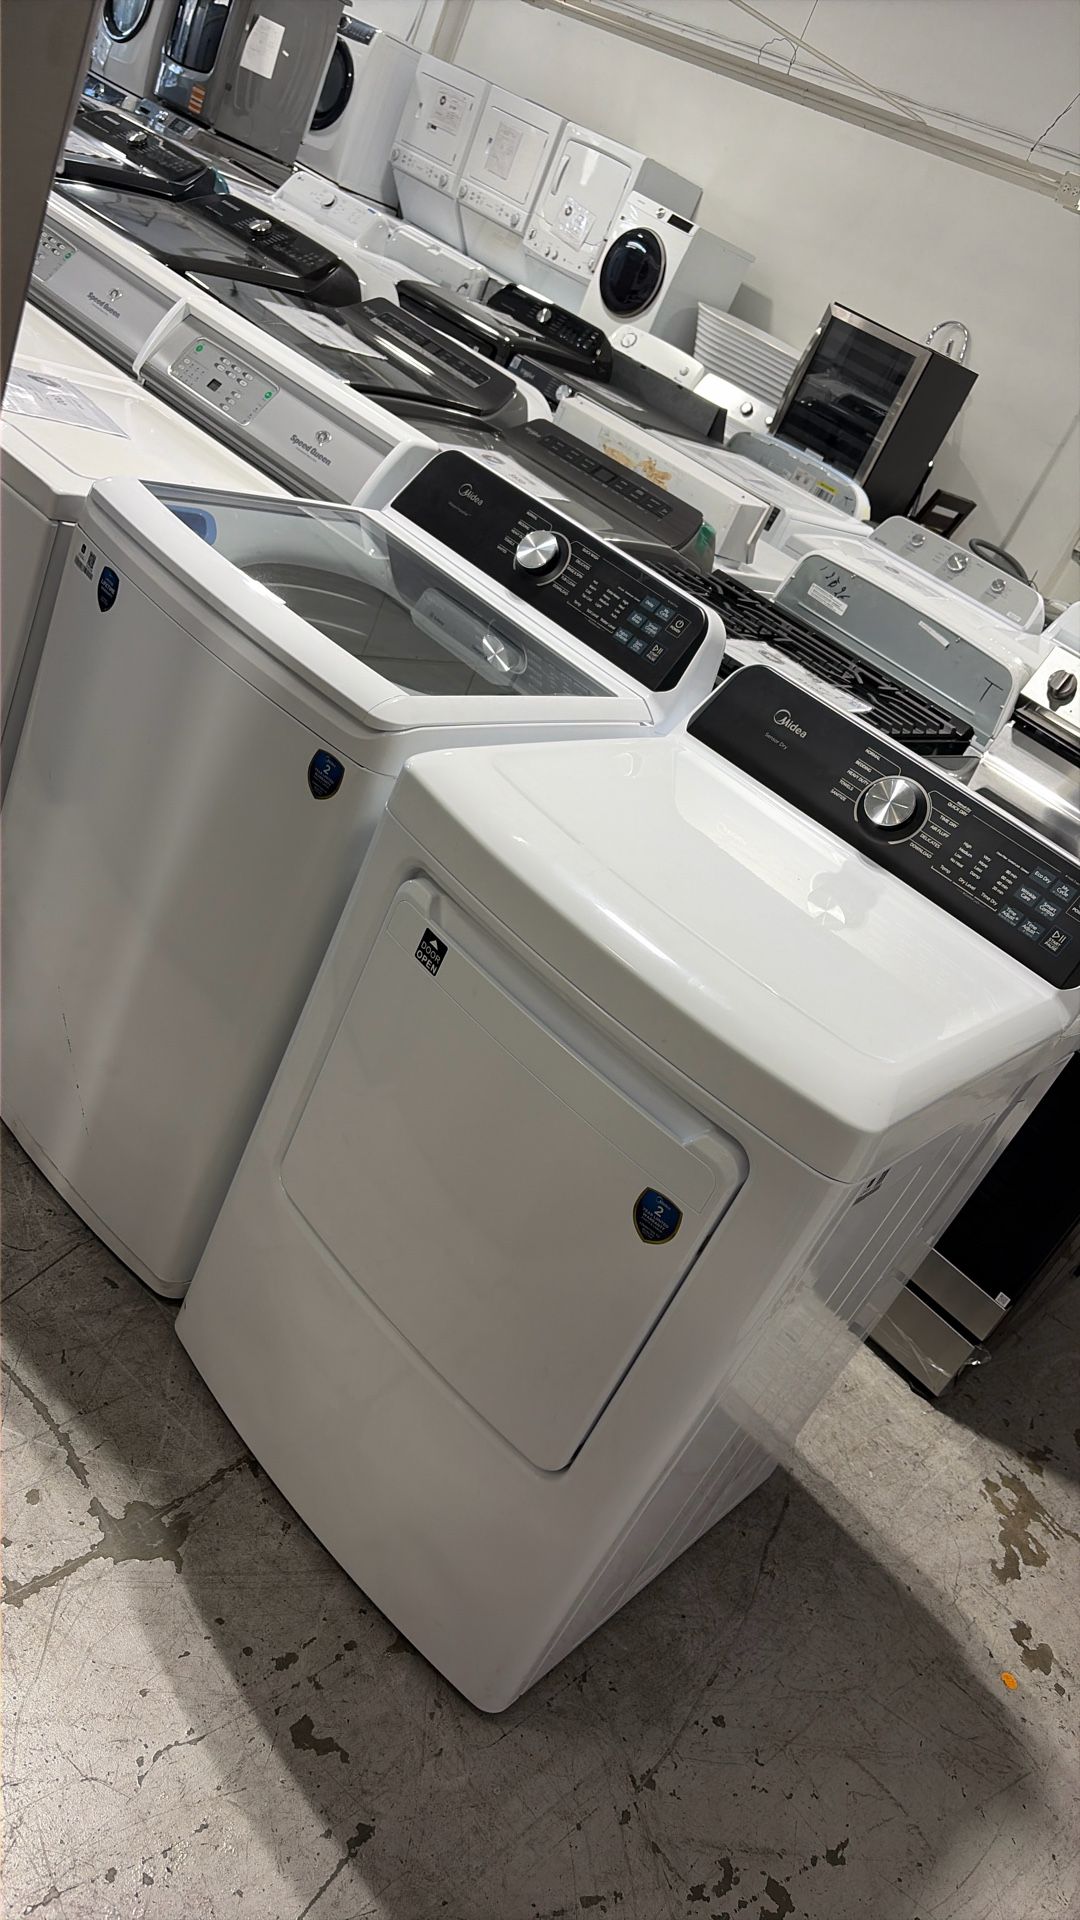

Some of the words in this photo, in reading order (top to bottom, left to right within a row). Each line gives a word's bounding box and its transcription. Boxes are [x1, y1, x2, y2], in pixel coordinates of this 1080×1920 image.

[88, 292, 106, 306] Speed
[102, 303, 120, 318] Queen
[290, 434, 312, 452] Speed
[310, 448, 332, 466] Queen
[458, 483, 484, 506] Midea
[979, 676, 1004, 702] T
[774, 708, 807, 738] Midea
[764, 732, 780, 744] Sensor
[779, 742, 788, 750] Dry
[865, 748, 880, 760] NORMAL
[322, 764, 331, 775] 2
[855, 760, 872, 772] BEDDING
[846, 770, 859, 780] HEAVY
[858, 777, 869, 786] DUTY
[840, 780, 854, 792] TOWELS
[830, 788, 847, 802] SANITIZE
[948, 802, 960, 812] QUICK
[959, 808, 968, 816] DRY
[940, 814, 950, 824] TIME
[948, 820, 958, 828] DRY
[937, 829, 950, 838] FLUFF
[920, 834, 940, 849] DELICATES
[910, 842, 932, 859] DOWNLOAD
[958, 847, 973, 858] Medium
[978, 860, 988, 868] More
[984, 854, 992, 862] Very
[940, 864, 951, 874] Temp
[970, 870, 980, 880] Damp
[1034, 870, 1044, 879] Eco
[1042, 876, 1052, 884] Dry
[966, 881, 976, 891] Level
[1062, 885, 1070, 894] My
[1020, 888, 1037, 900] Wrinkle
[1020, 893, 1030, 902] Care
[1056, 887, 1068, 898] Cycle
[980, 892, 991, 901] Time
[990, 898, 998, 906] Dry
[1007, 907, 1017, 916] Time
[1040, 904, 1055, 917] Control
[1044, 902, 1056, 912] Smart
[1027, 921, 1038, 930] Time
[1044, 942, 1056, 952] PAUSE
[1048, 937, 1060, 946] START
[421, 940, 440, 964] DOOR
[416, 950, 438, 974] OPEN
[643, 1207, 654, 1216] YEAR
[654, 1216, 669, 1228] LIMITED
[654, 1206, 664, 1218] 2
[642, 1213, 666, 1230] WARRANTY
